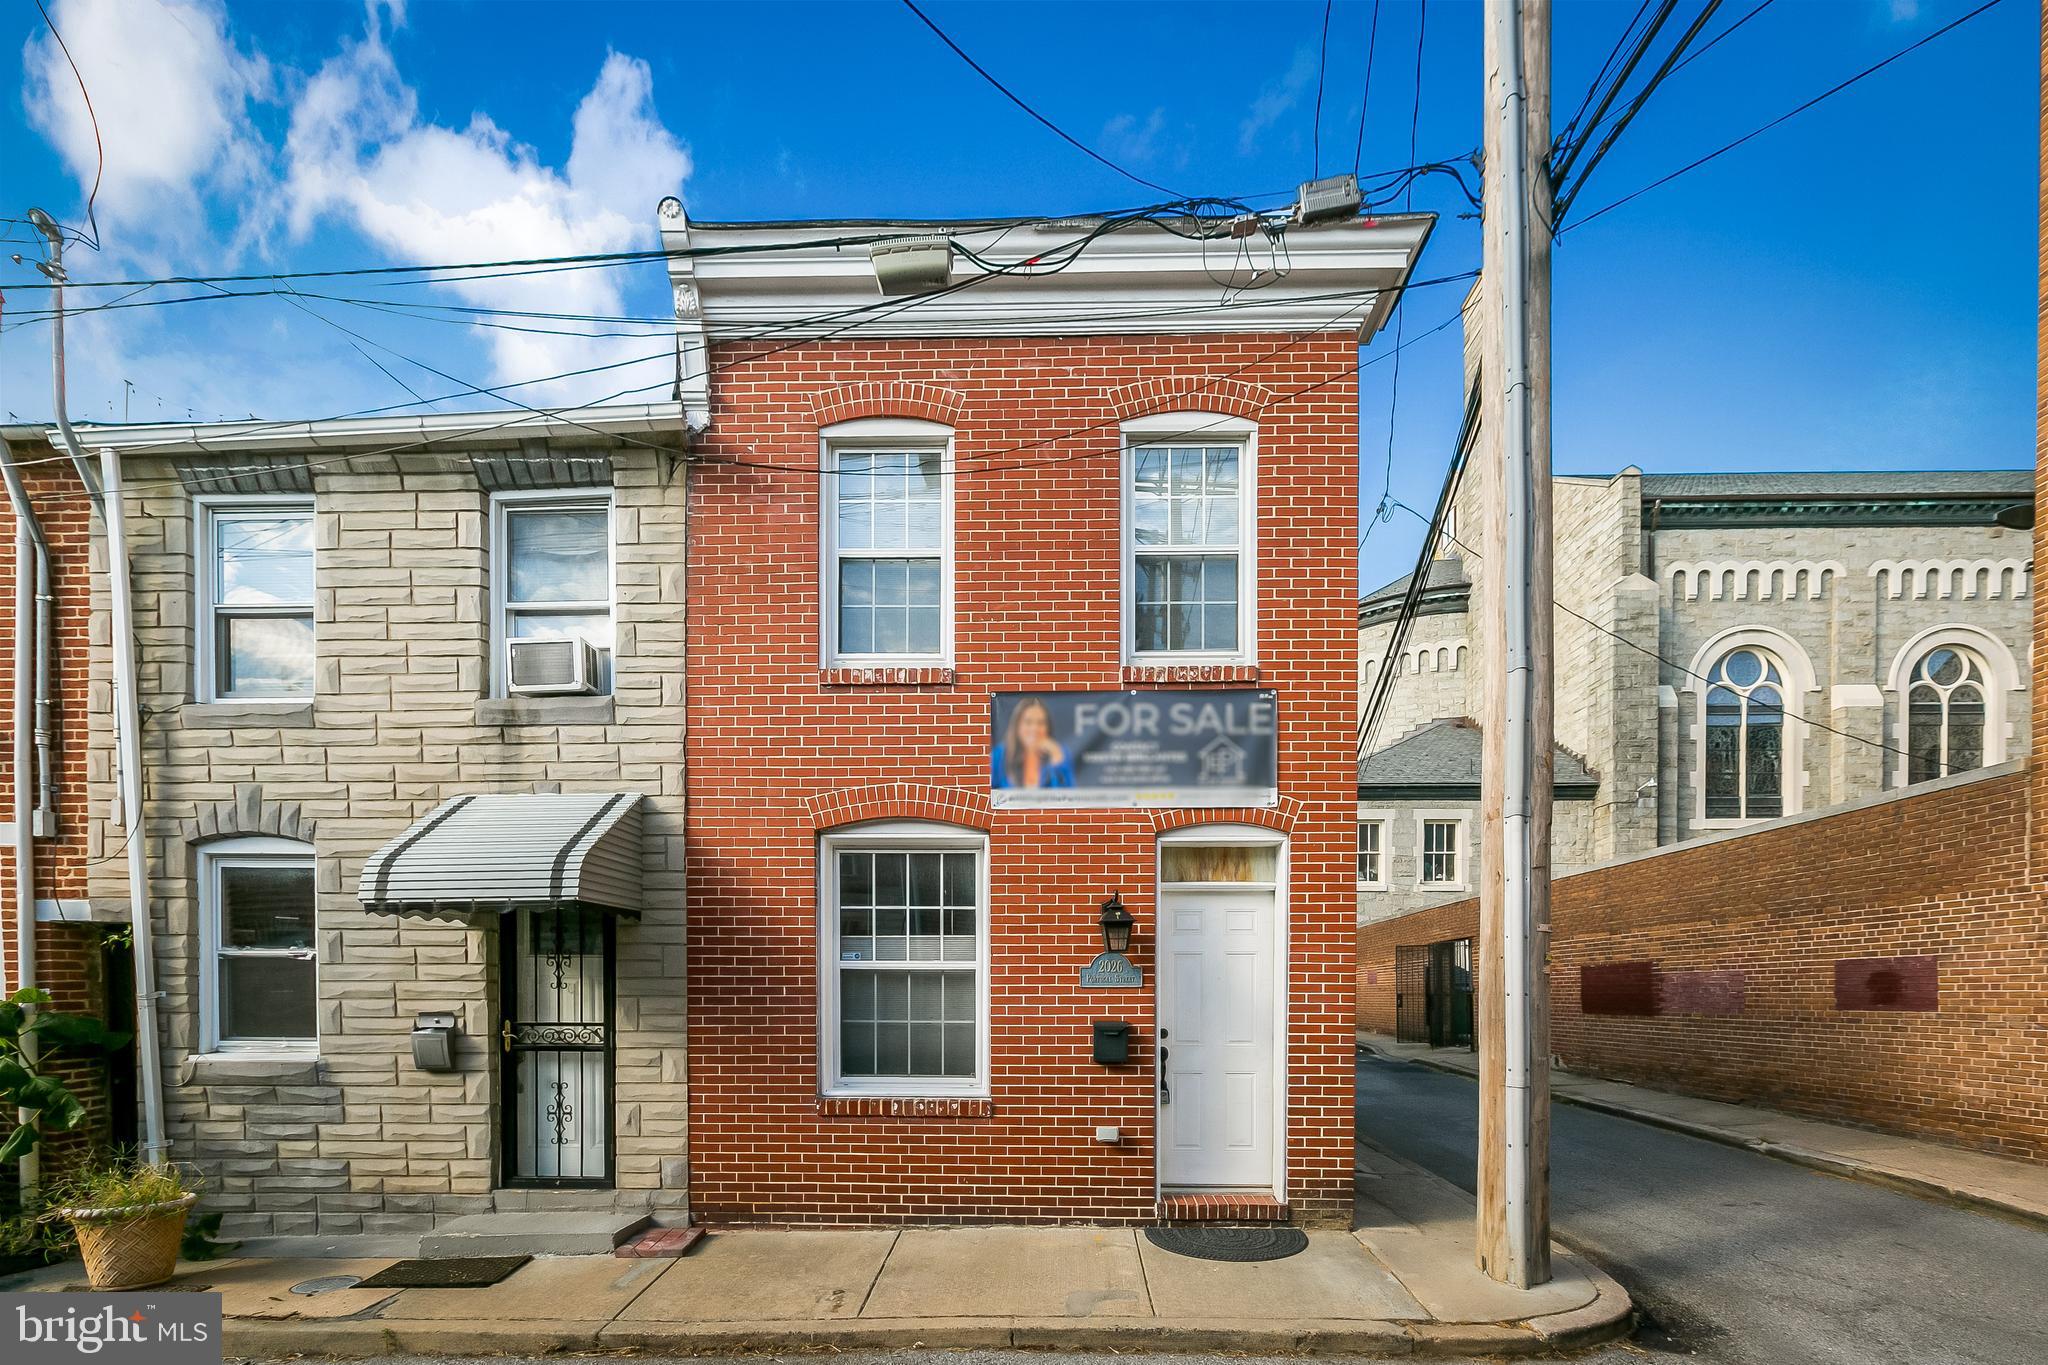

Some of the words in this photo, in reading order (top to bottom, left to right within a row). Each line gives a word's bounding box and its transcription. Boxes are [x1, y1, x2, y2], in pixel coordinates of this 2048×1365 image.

[1073, 703, 1160, 736] FOR
[1169, 703, 1272, 736] SALE
[1098, 960, 1123, 973] 2026
